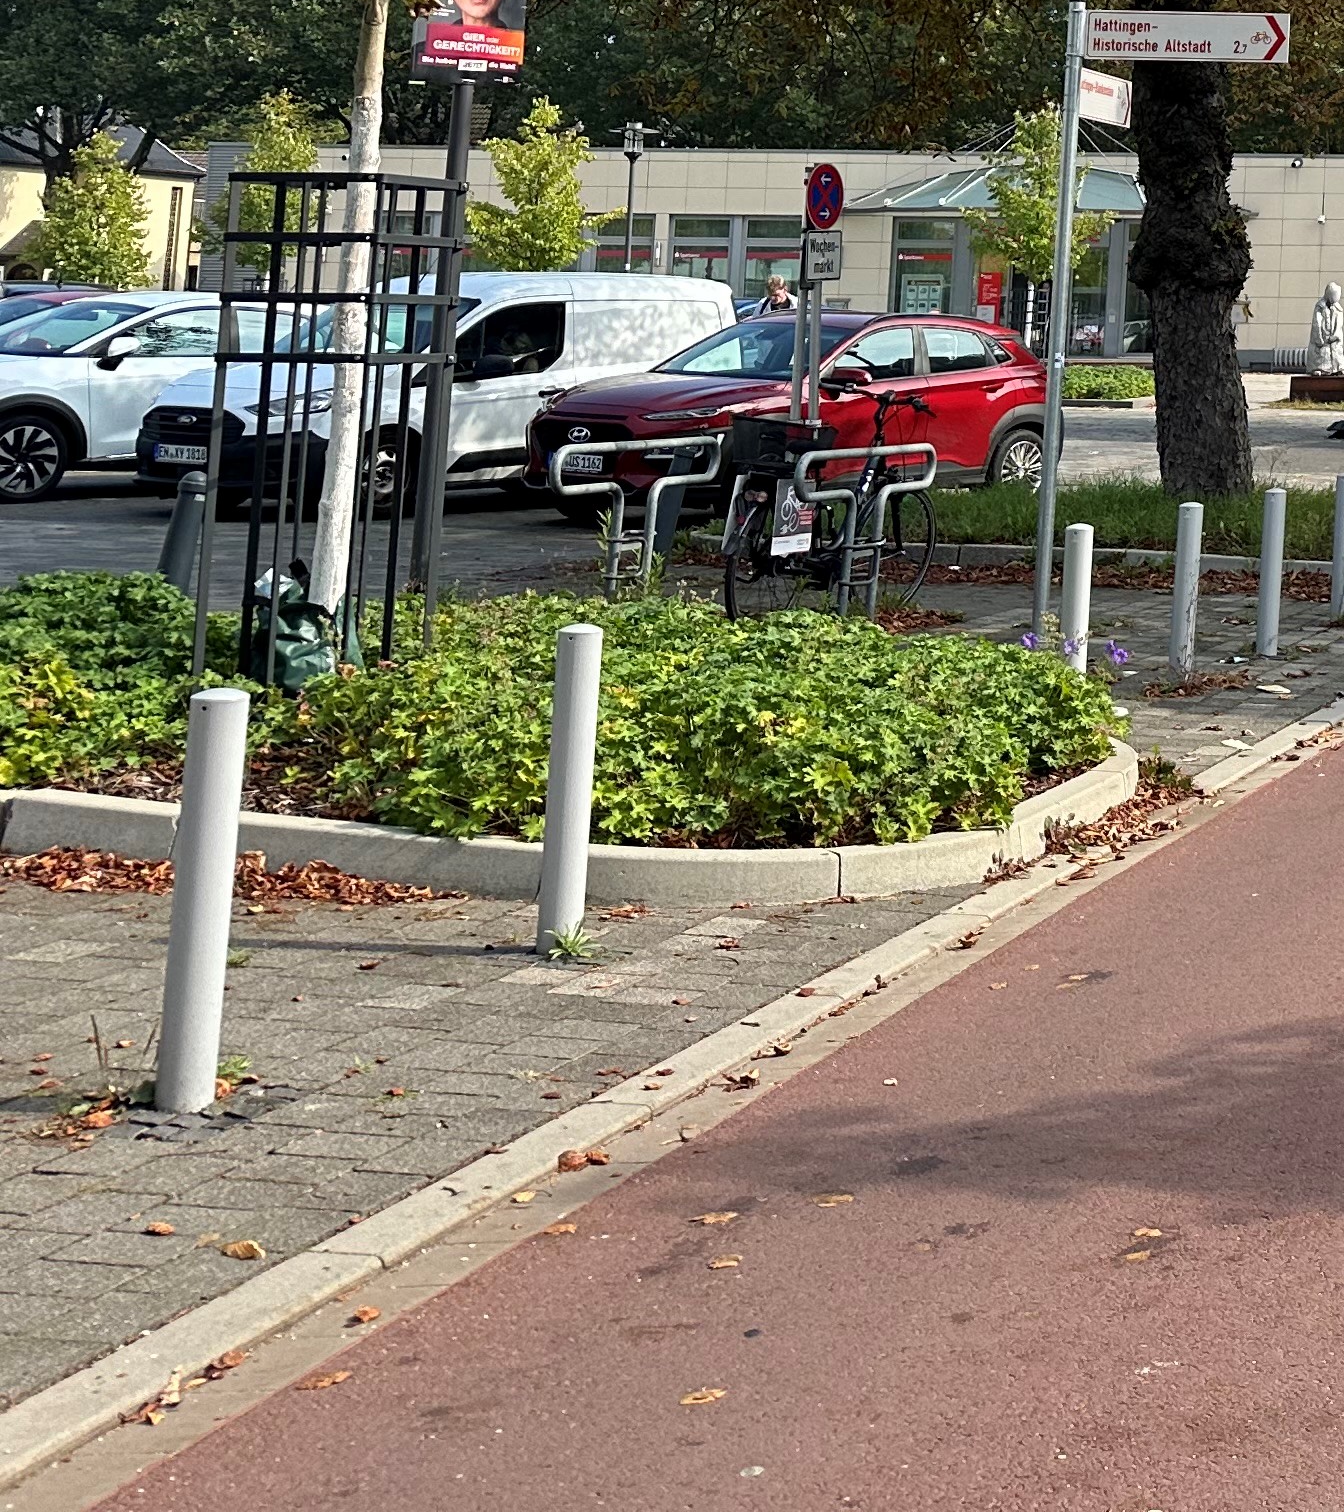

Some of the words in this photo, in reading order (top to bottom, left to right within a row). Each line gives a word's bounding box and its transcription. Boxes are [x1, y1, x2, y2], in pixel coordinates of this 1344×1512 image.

[1093, 18, 1159, 35] Hattingen-
[462, 32, 486, 42] GIER
[432, 39, 521, 57] GERECHTIGKEIT?
[1092, 38, 1159, 52] Historische
[1164, 39, 1212, 53] Altstadt
[810, 238, 840, 253] Wochen-
[813, 259, 834, 274] markt
[159, 446, 169, 459] EN
[581, 456, 602, 469] 1162
